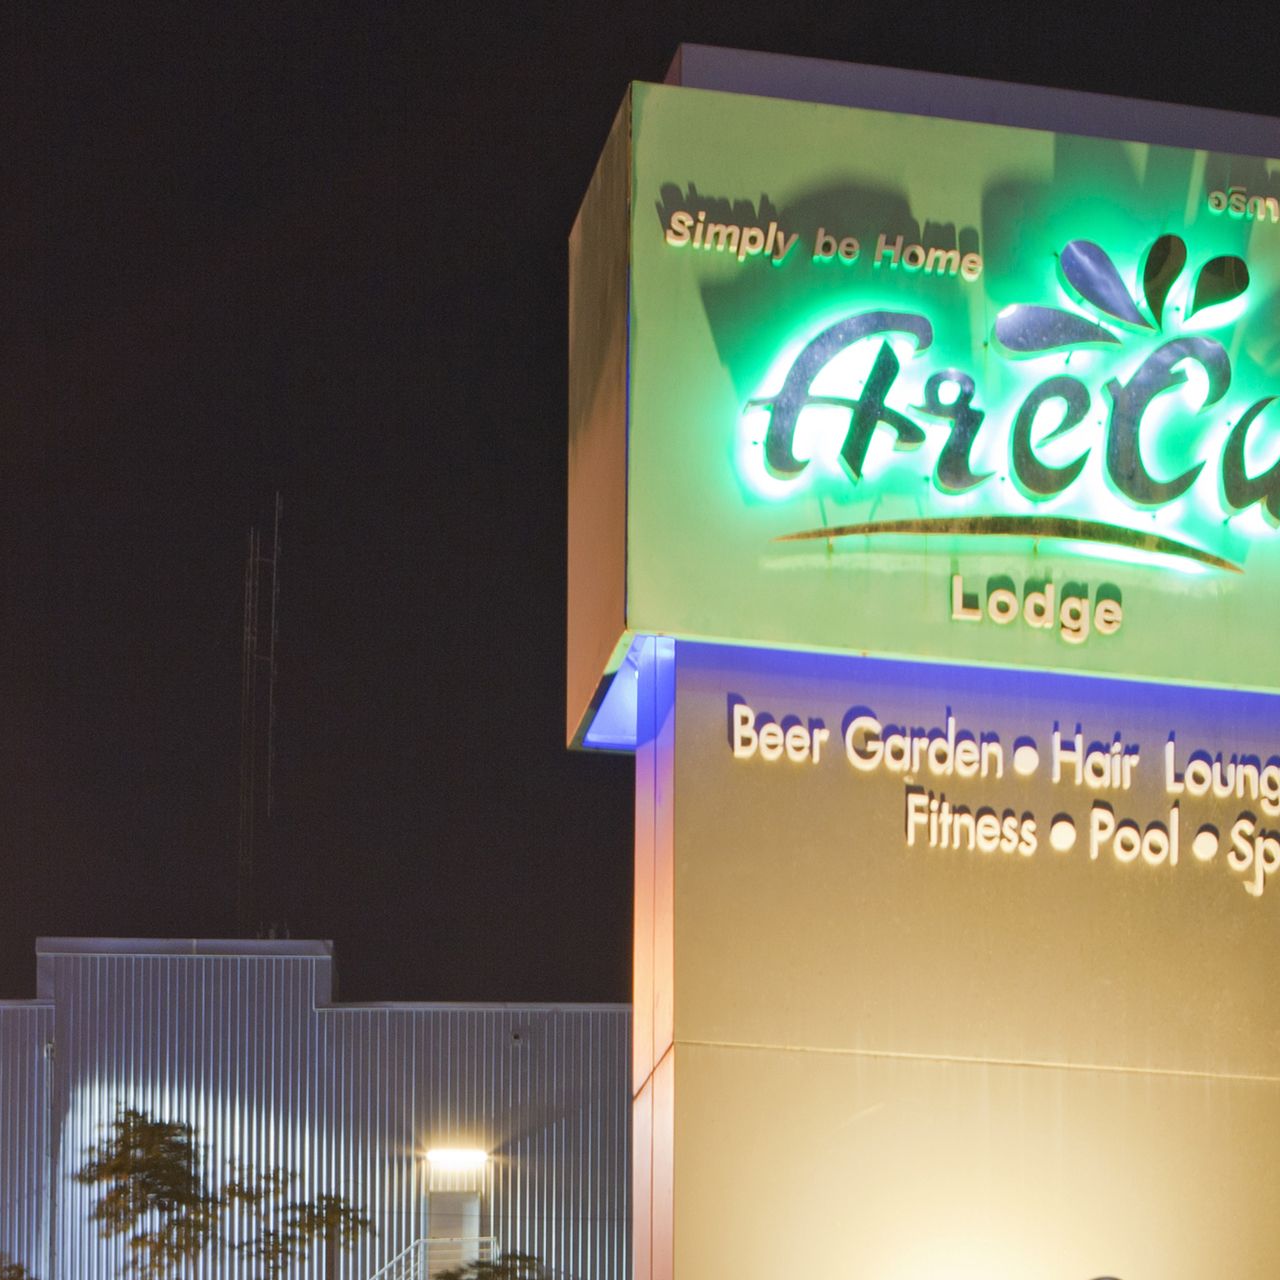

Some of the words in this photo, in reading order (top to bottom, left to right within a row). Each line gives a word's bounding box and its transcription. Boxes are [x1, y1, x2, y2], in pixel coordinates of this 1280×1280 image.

[666, 210, 799, 265] Simply
[813, 227, 860, 263] be
[874, 234, 983, 281] Home
[951, 576, 1123, 644] Lodge
[733, 704, 830, 764] Beer
[845, 709, 1002, 779] Garden
[1052, 727, 1139, 789] Hair
[907, 793, 1036, 856] Fitness
[1090, 807, 1177, 866] Pool
